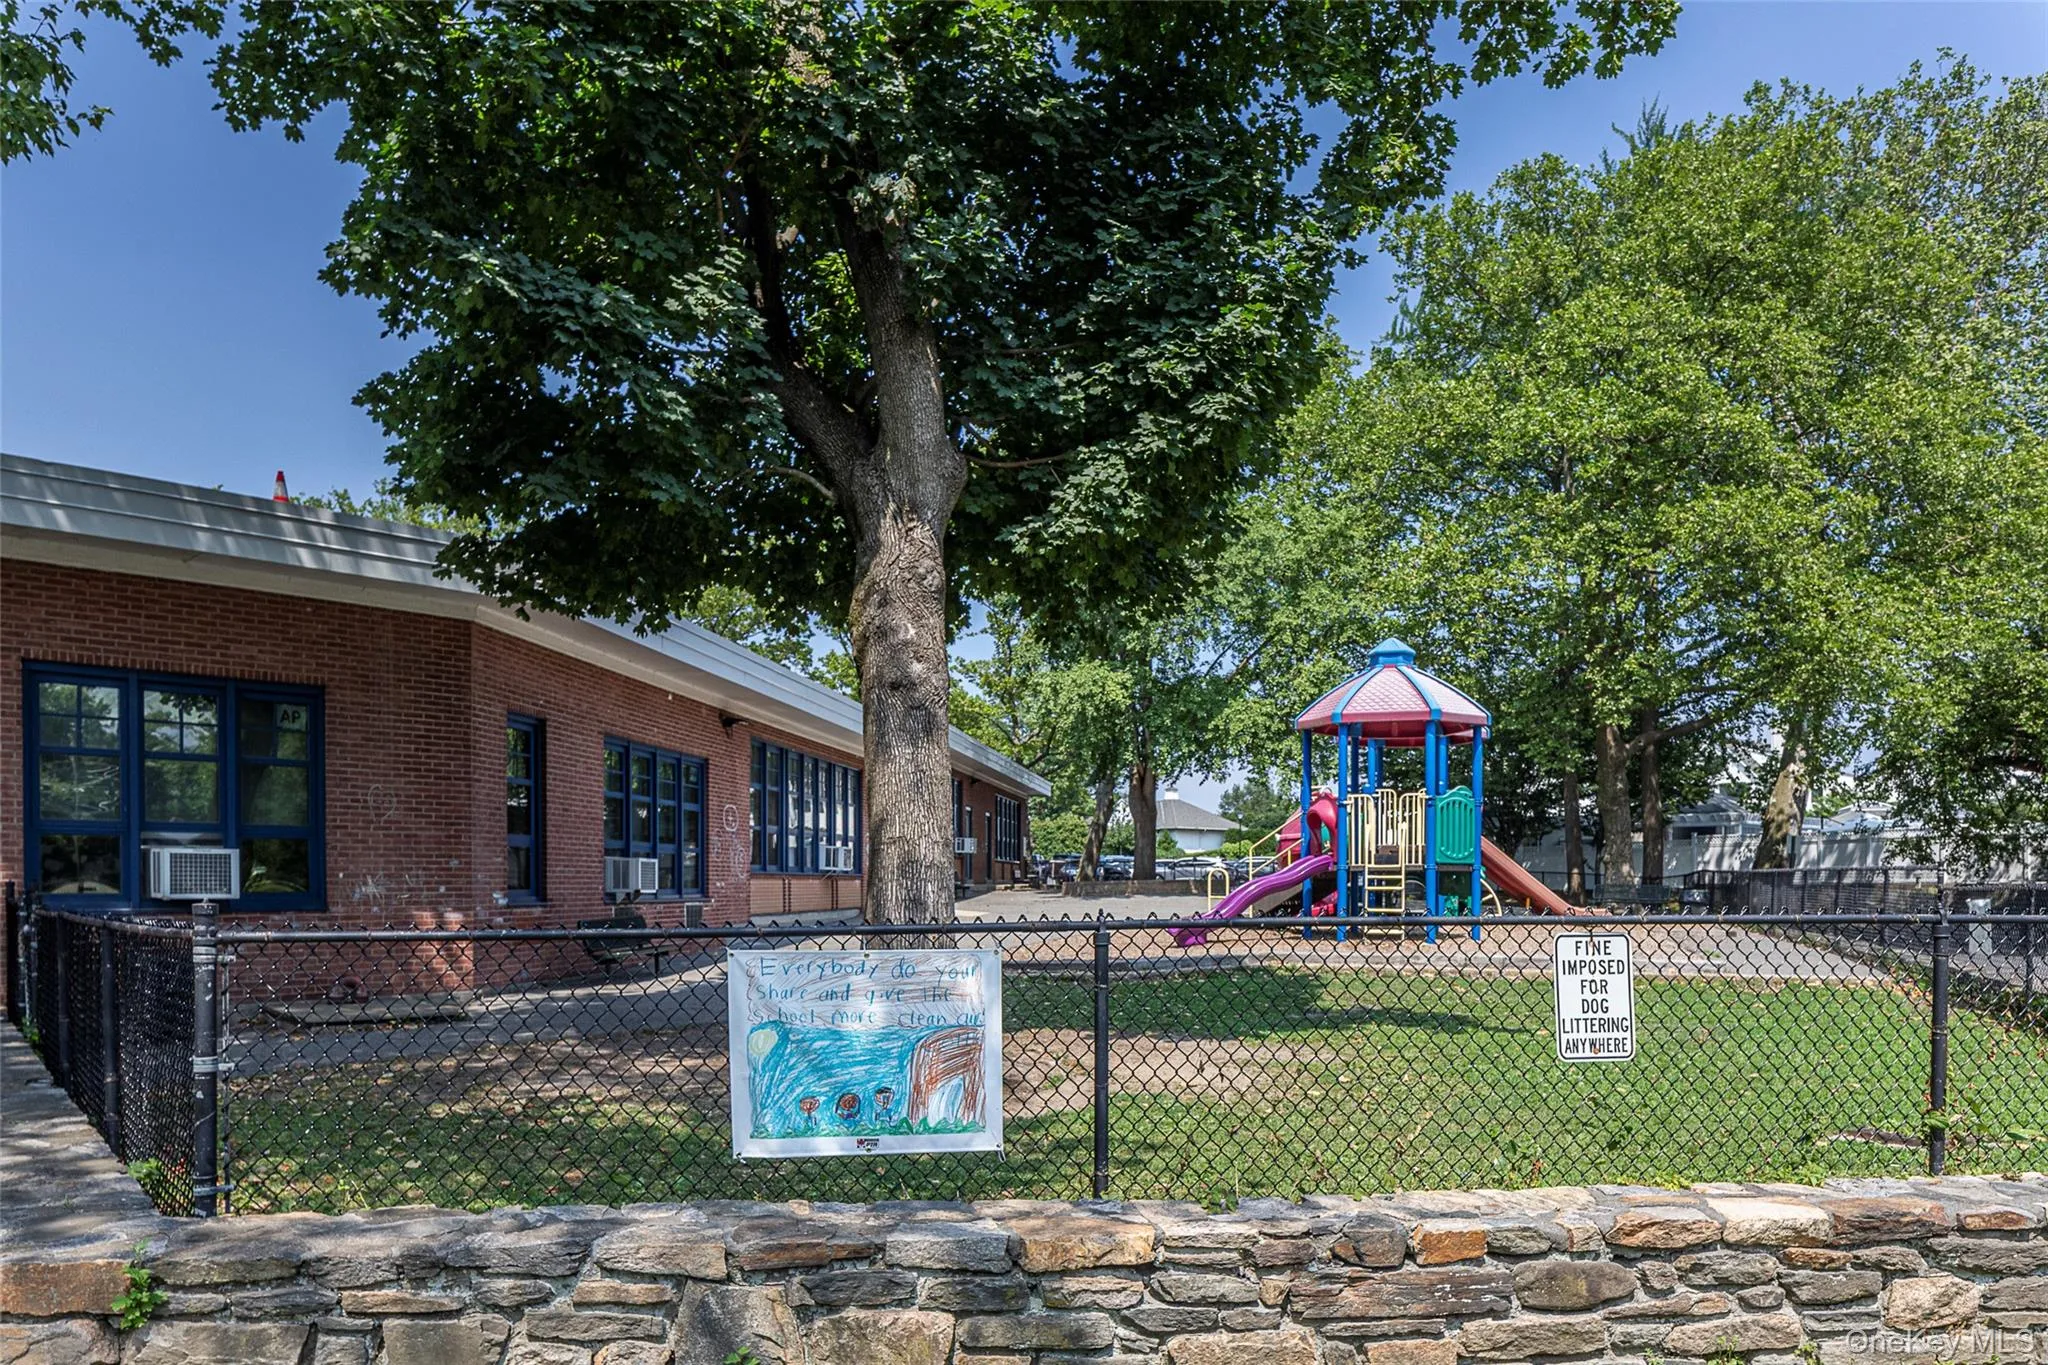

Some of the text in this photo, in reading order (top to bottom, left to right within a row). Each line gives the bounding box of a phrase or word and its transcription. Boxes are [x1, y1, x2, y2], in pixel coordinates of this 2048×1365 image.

[1575, 940, 1612, 956] FINE
[760, 957, 978, 988] Everybody do your
[1562, 959, 1625, 975] IMPOSED
[818, 983, 851, 1001] and
[865, 987, 905, 1007] give
[923, 986, 952, 1002] the
[1580, 979, 1608, 995] FOR
[1581, 998, 1609, 1014] DOG
[831, 1009, 878, 1025] more
[898, 1010, 947, 1026] clean
[1562, 1016, 1629, 1034] LITTERING
[1565, 1037, 1628, 1054] ANYWHERE
